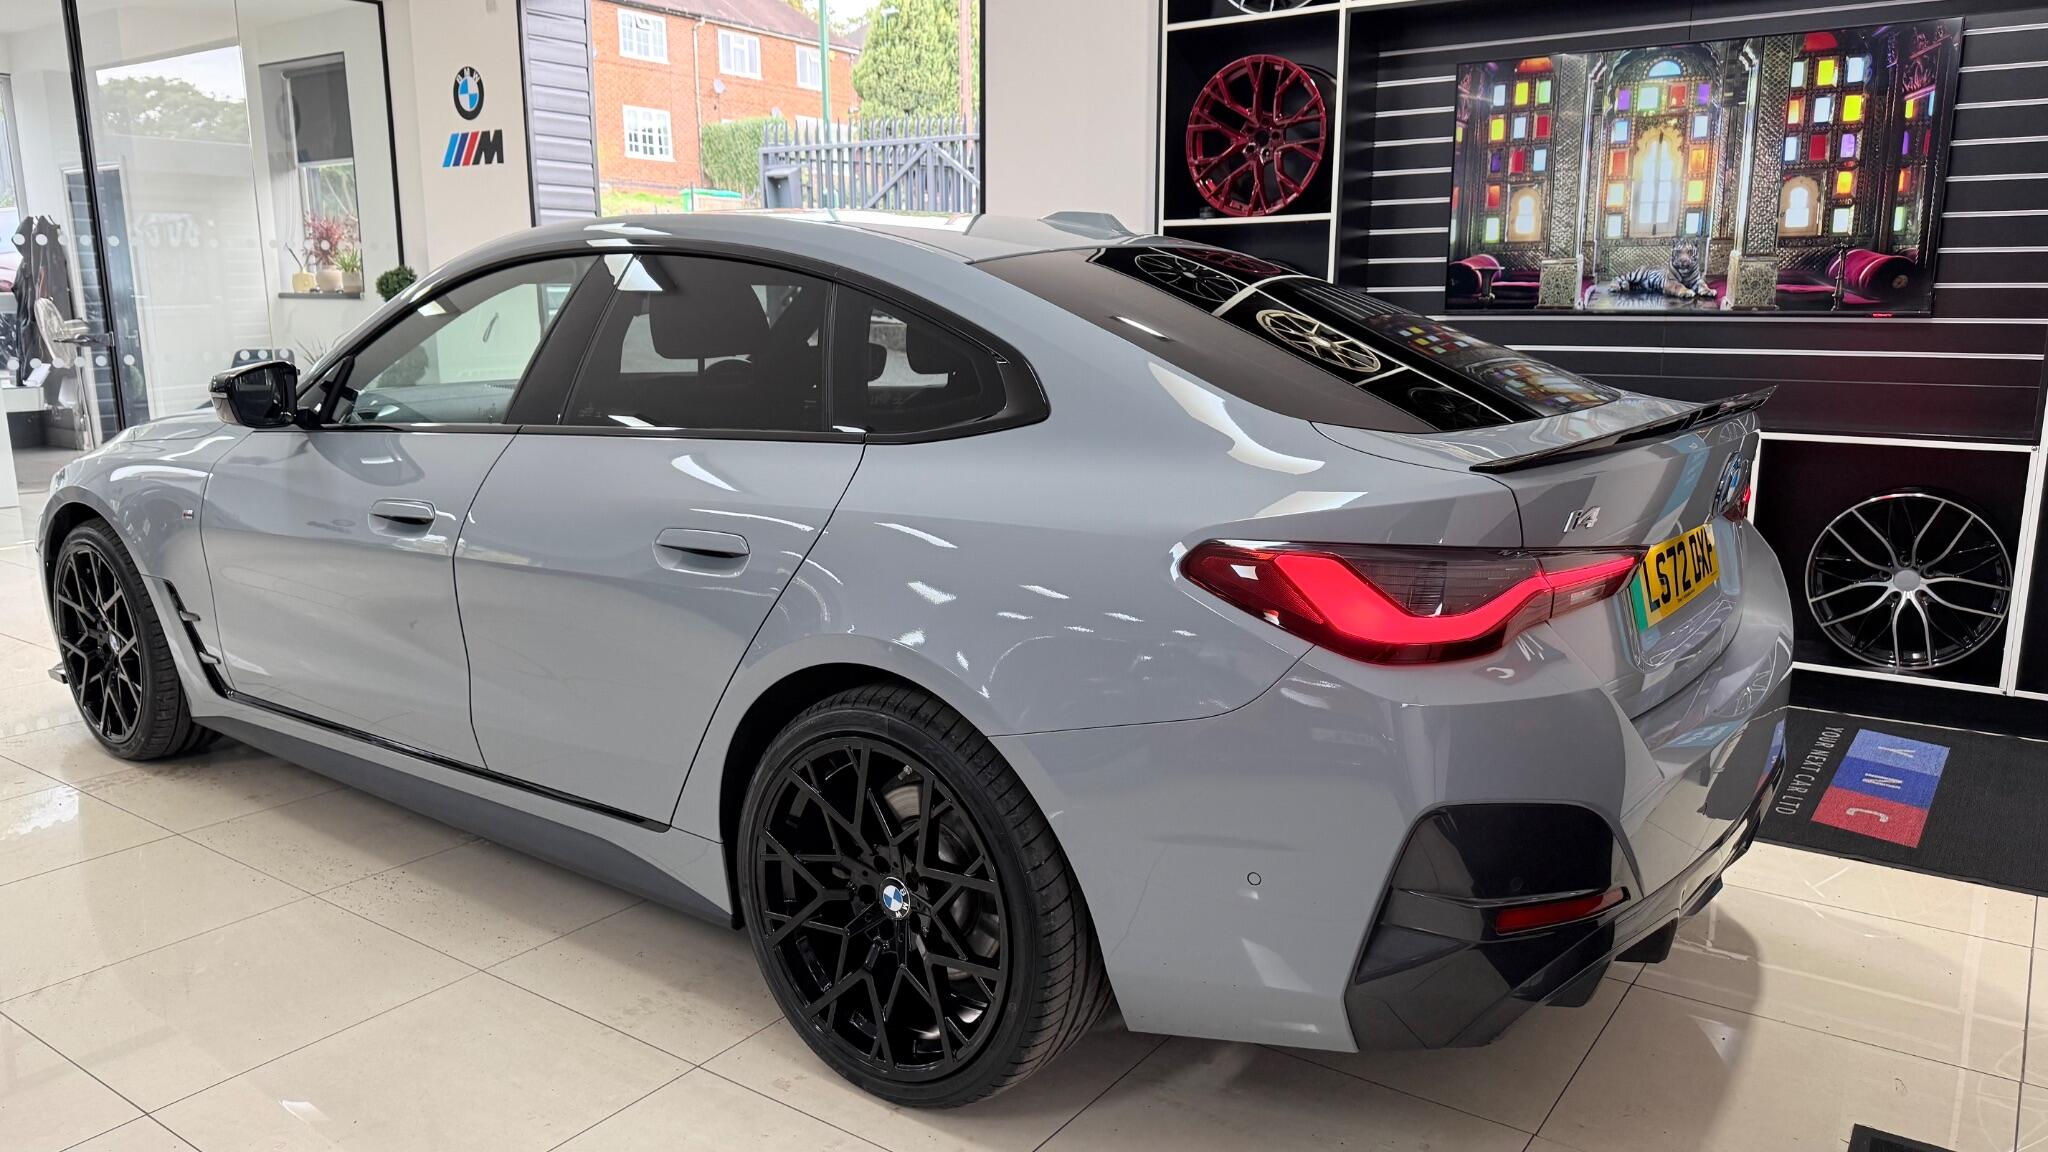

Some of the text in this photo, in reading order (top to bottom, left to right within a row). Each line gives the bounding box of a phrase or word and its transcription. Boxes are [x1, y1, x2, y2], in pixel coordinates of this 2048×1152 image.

[1563, 506, 1600, 533] i4
[1642, 527, 1712, 612] LS72 DXF
[1775, 726, 1844, 815] YOUR NEXT CAR LTD
